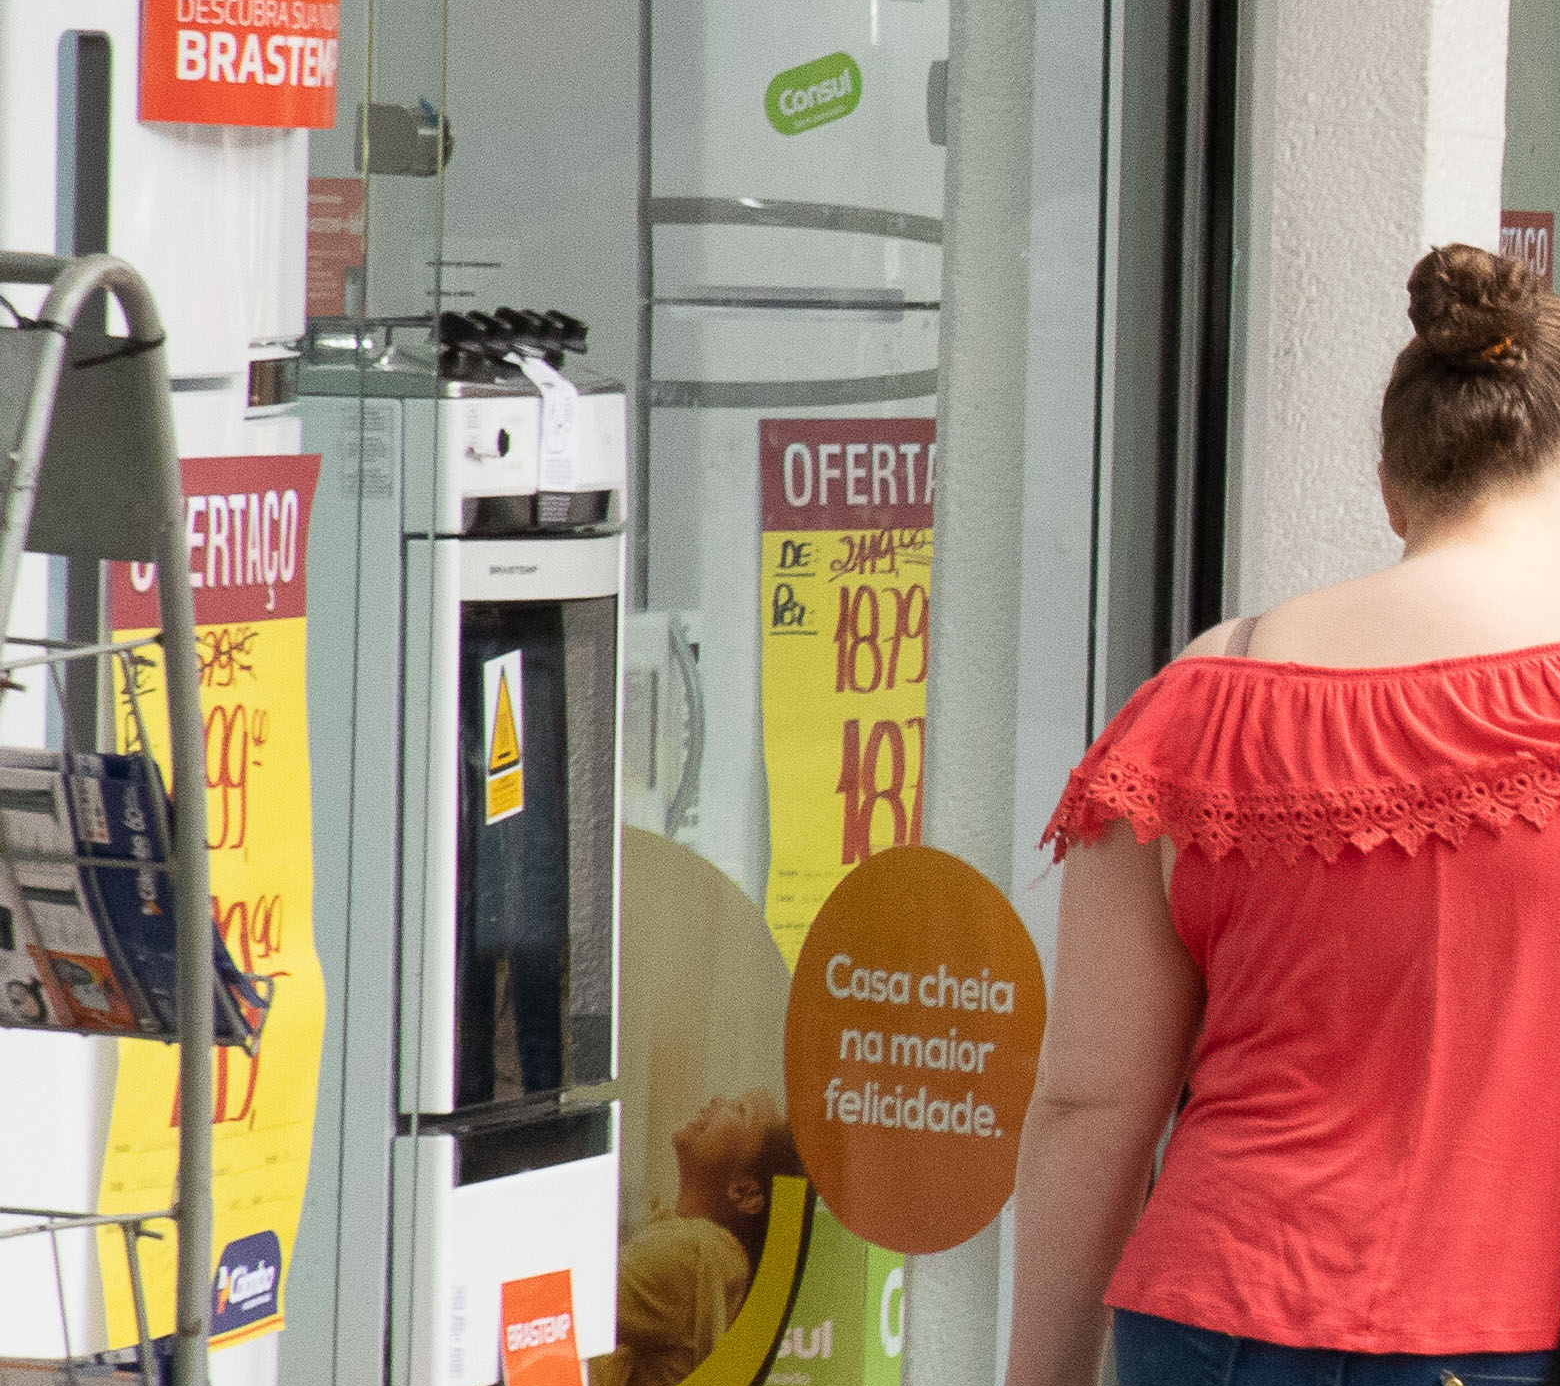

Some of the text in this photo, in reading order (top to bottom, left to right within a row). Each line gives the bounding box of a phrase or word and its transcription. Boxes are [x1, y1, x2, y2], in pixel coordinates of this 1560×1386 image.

[779, 69, 852, 117] Consul
[824, 954, 1016, 1014] Casa cheia
[840, 1024, 994, 1074] na maior
[823, 1078, 1003, 1138] felicidade.
